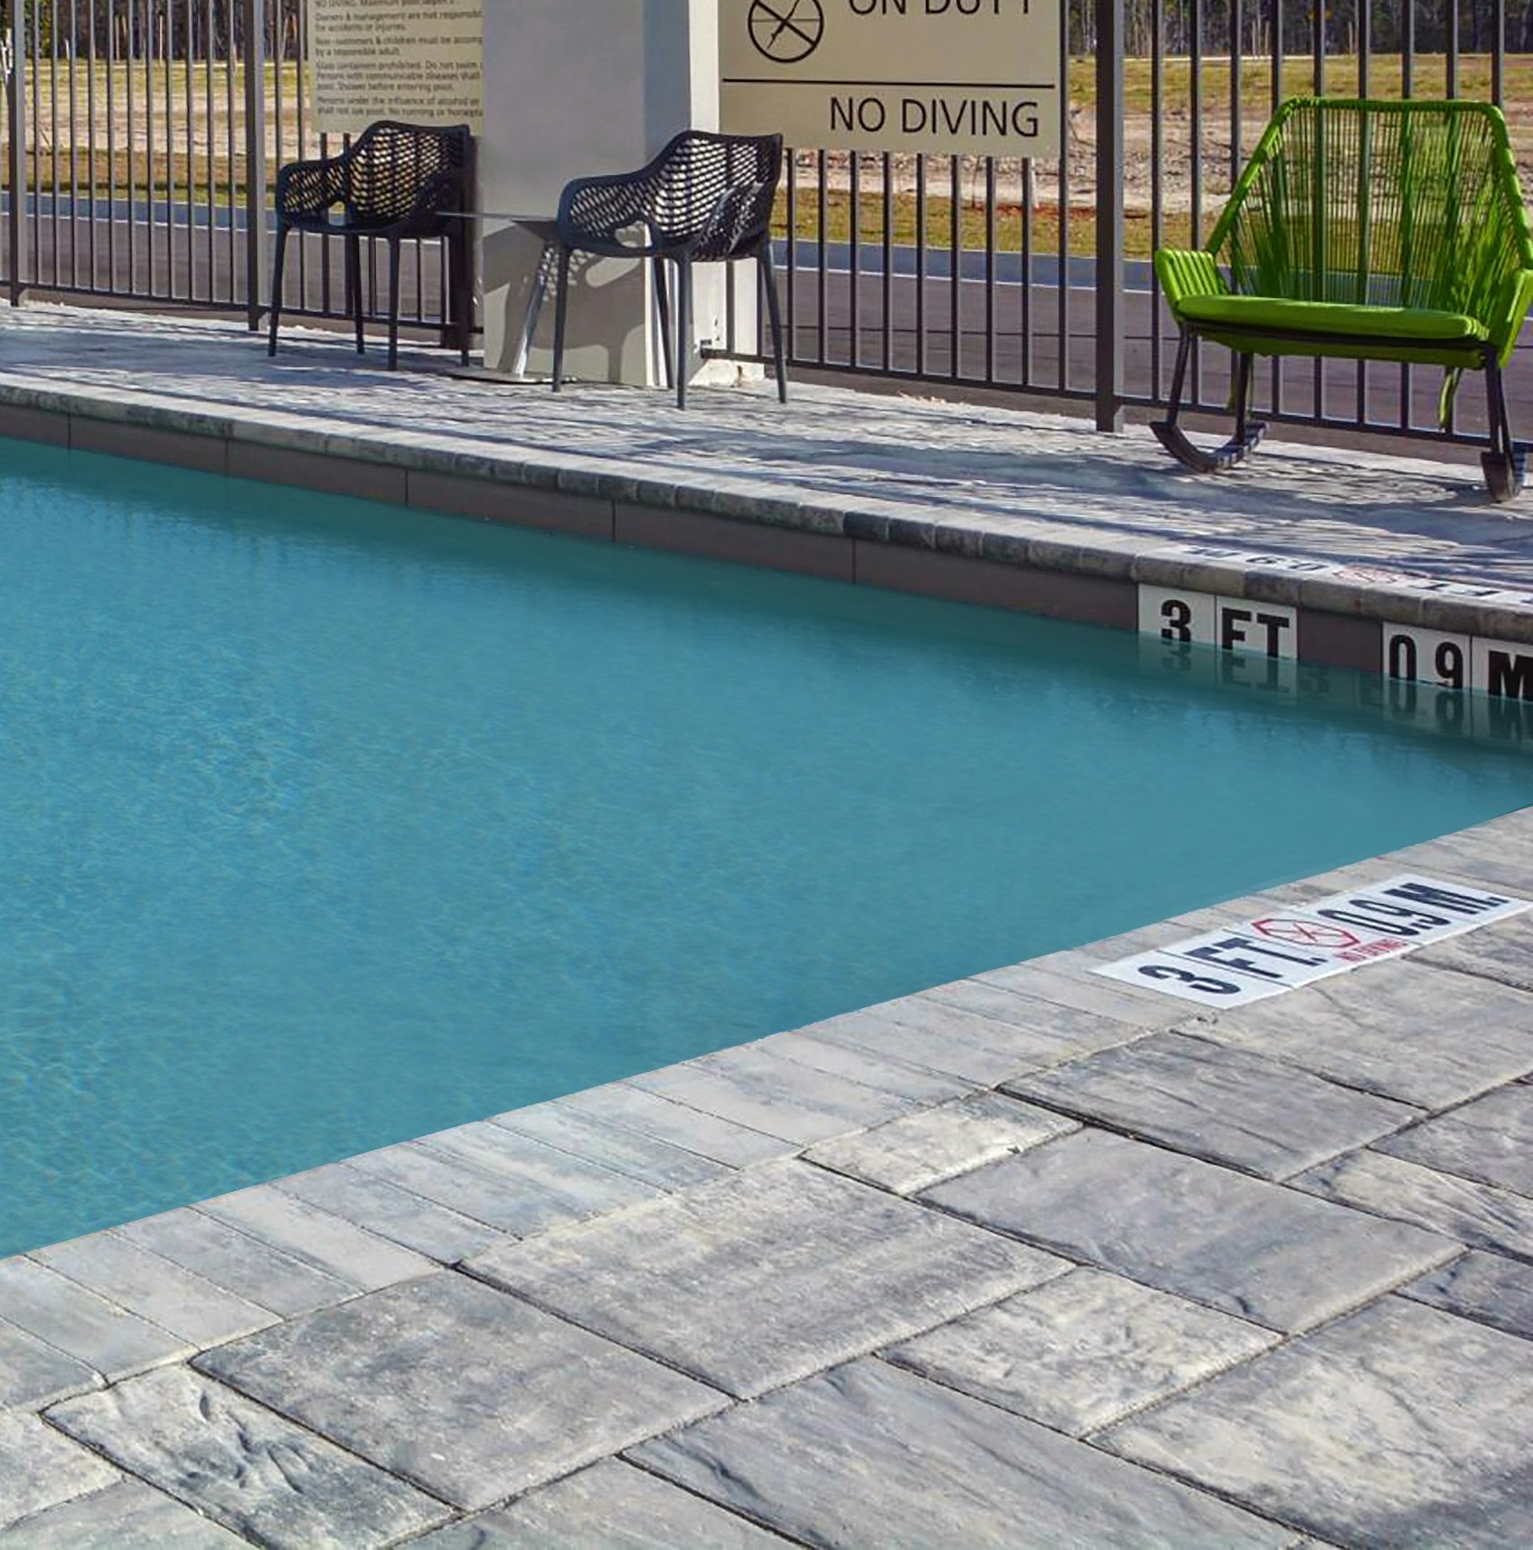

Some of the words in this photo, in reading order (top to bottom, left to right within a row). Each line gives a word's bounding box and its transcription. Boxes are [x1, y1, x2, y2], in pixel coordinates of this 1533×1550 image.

[830, 96, 885, 133] NO
[901, 99, 1039, 138] DIVING
[1161, 599, 1192, 643] 3
[1222, 606, 1290, 659] FT
[1488, 650, 1533, 702] M
[1316, 899, 1452, 937] 0.9
[1383, 881, 1512, 916] M.
[1186, 936, 1331, 979] FT.
[1138, 963, 1242, 995] 3
